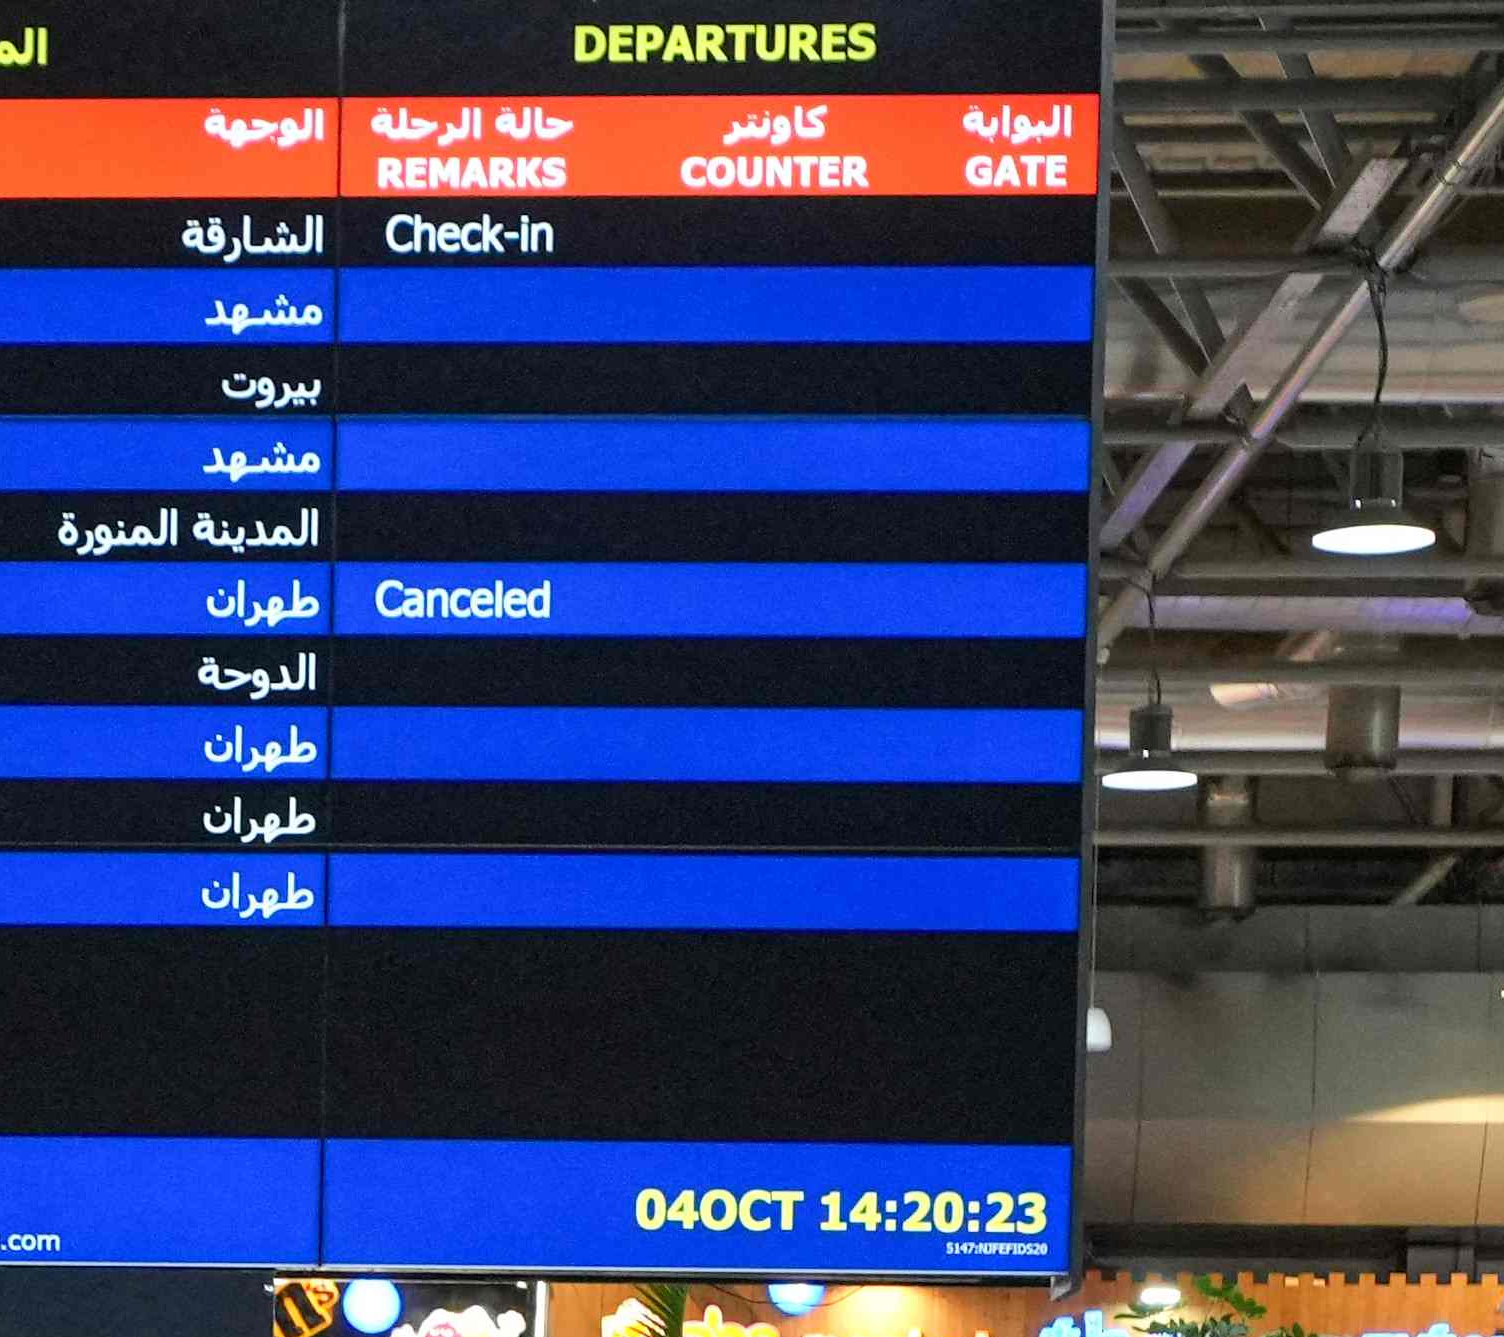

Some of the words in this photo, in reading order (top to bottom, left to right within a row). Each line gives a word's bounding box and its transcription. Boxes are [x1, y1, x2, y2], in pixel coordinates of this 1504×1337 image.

[574, 22, 877, 63] DEPARTURES
[203, 107, 325, 148] الوجهة
[370, 106, 483, 147] الرحلة
[494, 106, 575, 141] حالة
[722, 104, 828, 147] كاونتر
[962, 104, 1073, 143] البوابة
[377, 156, 567, 190] REMARKS
[680, 155, 869, 188] COUNTER
[965, 154, 1068, 188] GATE
[181, 214, 324, 263] الشارقة
[385, 213, 554, 253] Check-in
[204, 294, 323, 335] مشهد
[221, 373, 322, 409] بيروت
[202, 441, 321, 483] مشهد
[57, 507, 178, 556] المنورة
[192, 507, 319, 551] المدينة
[206, 579, 320, 627] طهران
[375, 579, 551, 619] Canceled
[197, 652, 316, 700] الدوحة
[204, 724, 318, 773] طهران
[203, 796, 316, 844] طهران
[201, 871, 314, 919] طهران
[635, 1188, 805, 1232] 04OCT
[820, 1190, 1047, 1235] 14:20:23
